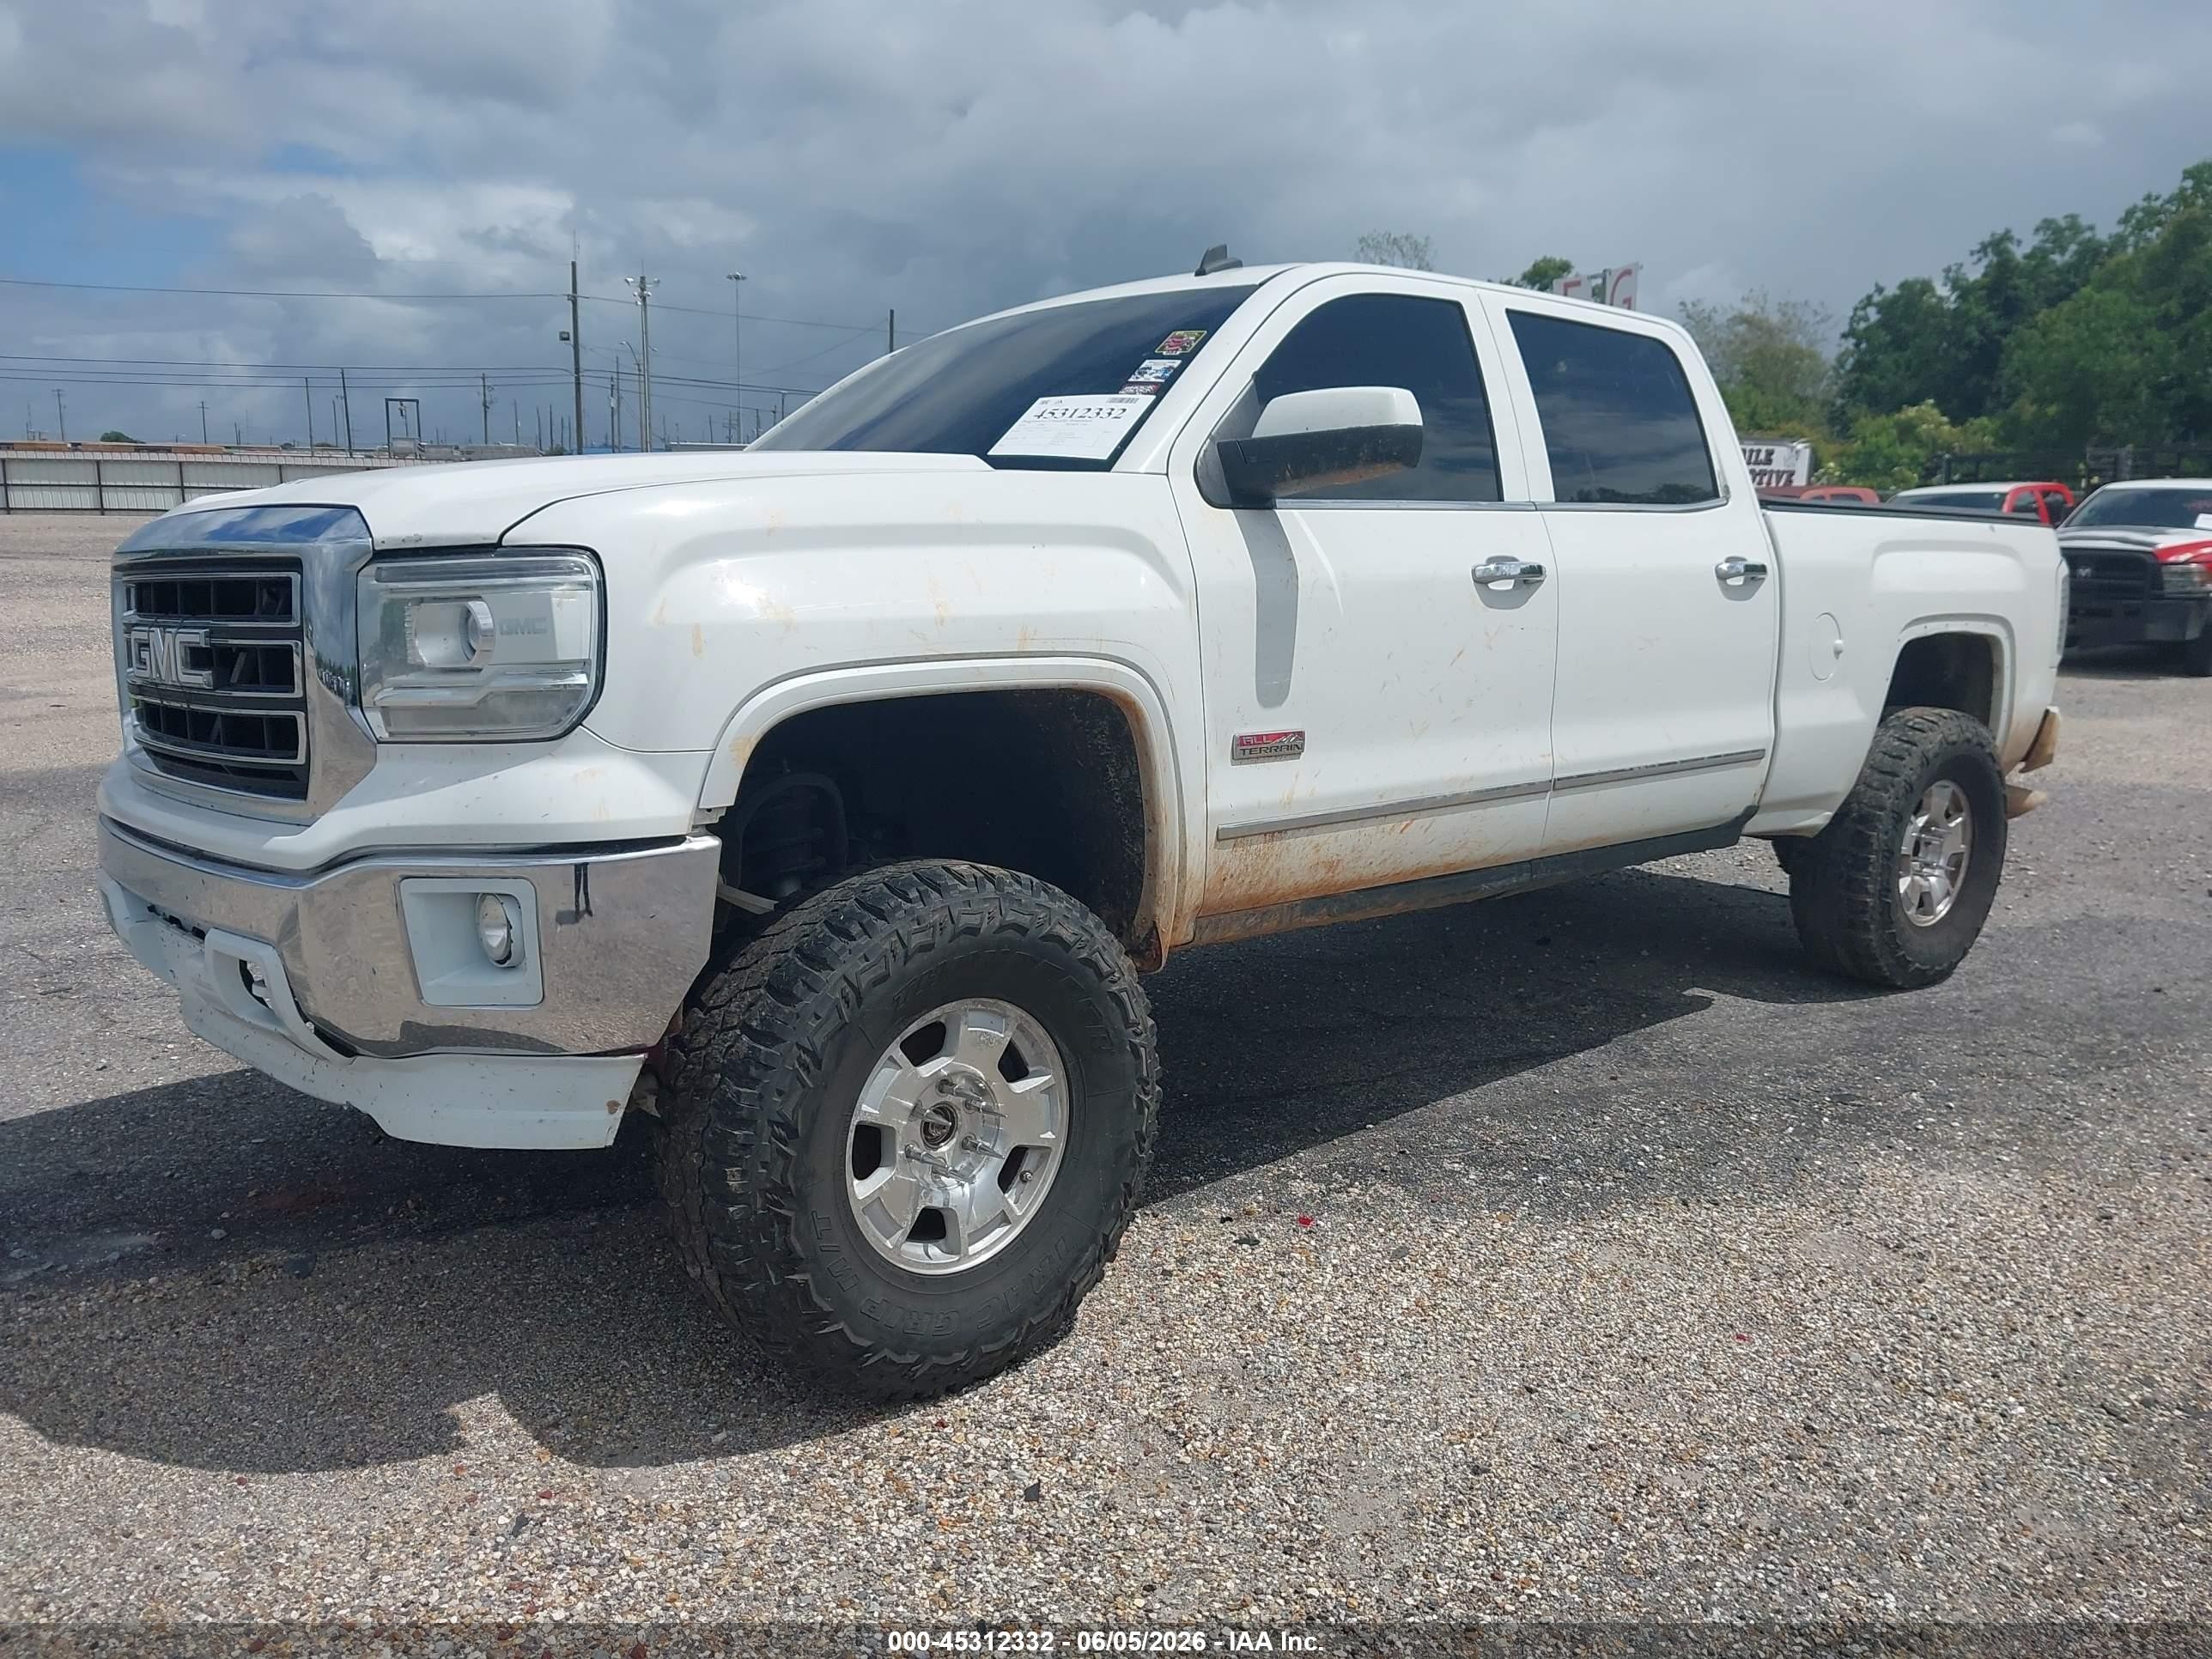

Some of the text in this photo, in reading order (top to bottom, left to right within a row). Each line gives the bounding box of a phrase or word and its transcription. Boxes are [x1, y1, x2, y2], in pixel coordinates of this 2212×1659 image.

[1032, 407, 1127, 420] 45312332
[1741, 447, 1775, 465] ILE
[499, 617, 547, 635] GMC
[131, 627, 213, 689] GMC
[1243, 735, 1273, 744] ALL
[1239, 743, 1304, 756] TERRAIN
[860, 1297, 961, 1337] GRIP
